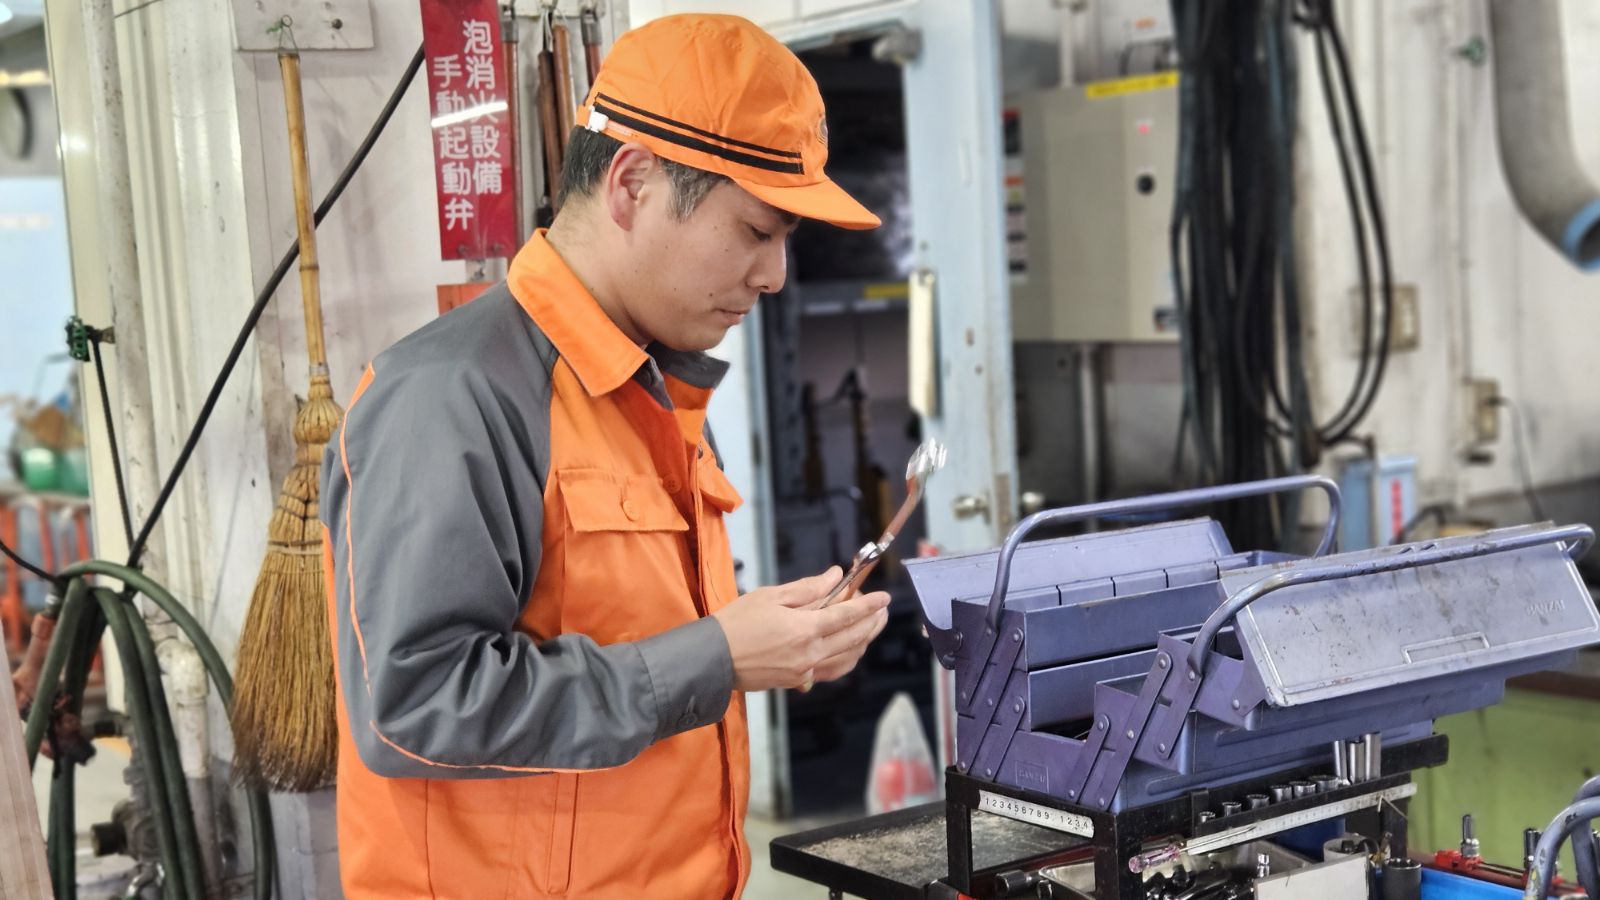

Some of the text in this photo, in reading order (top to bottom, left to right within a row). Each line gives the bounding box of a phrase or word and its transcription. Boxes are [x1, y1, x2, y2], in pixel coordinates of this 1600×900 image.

[462, 19, 502, 194] 泡消火設備
